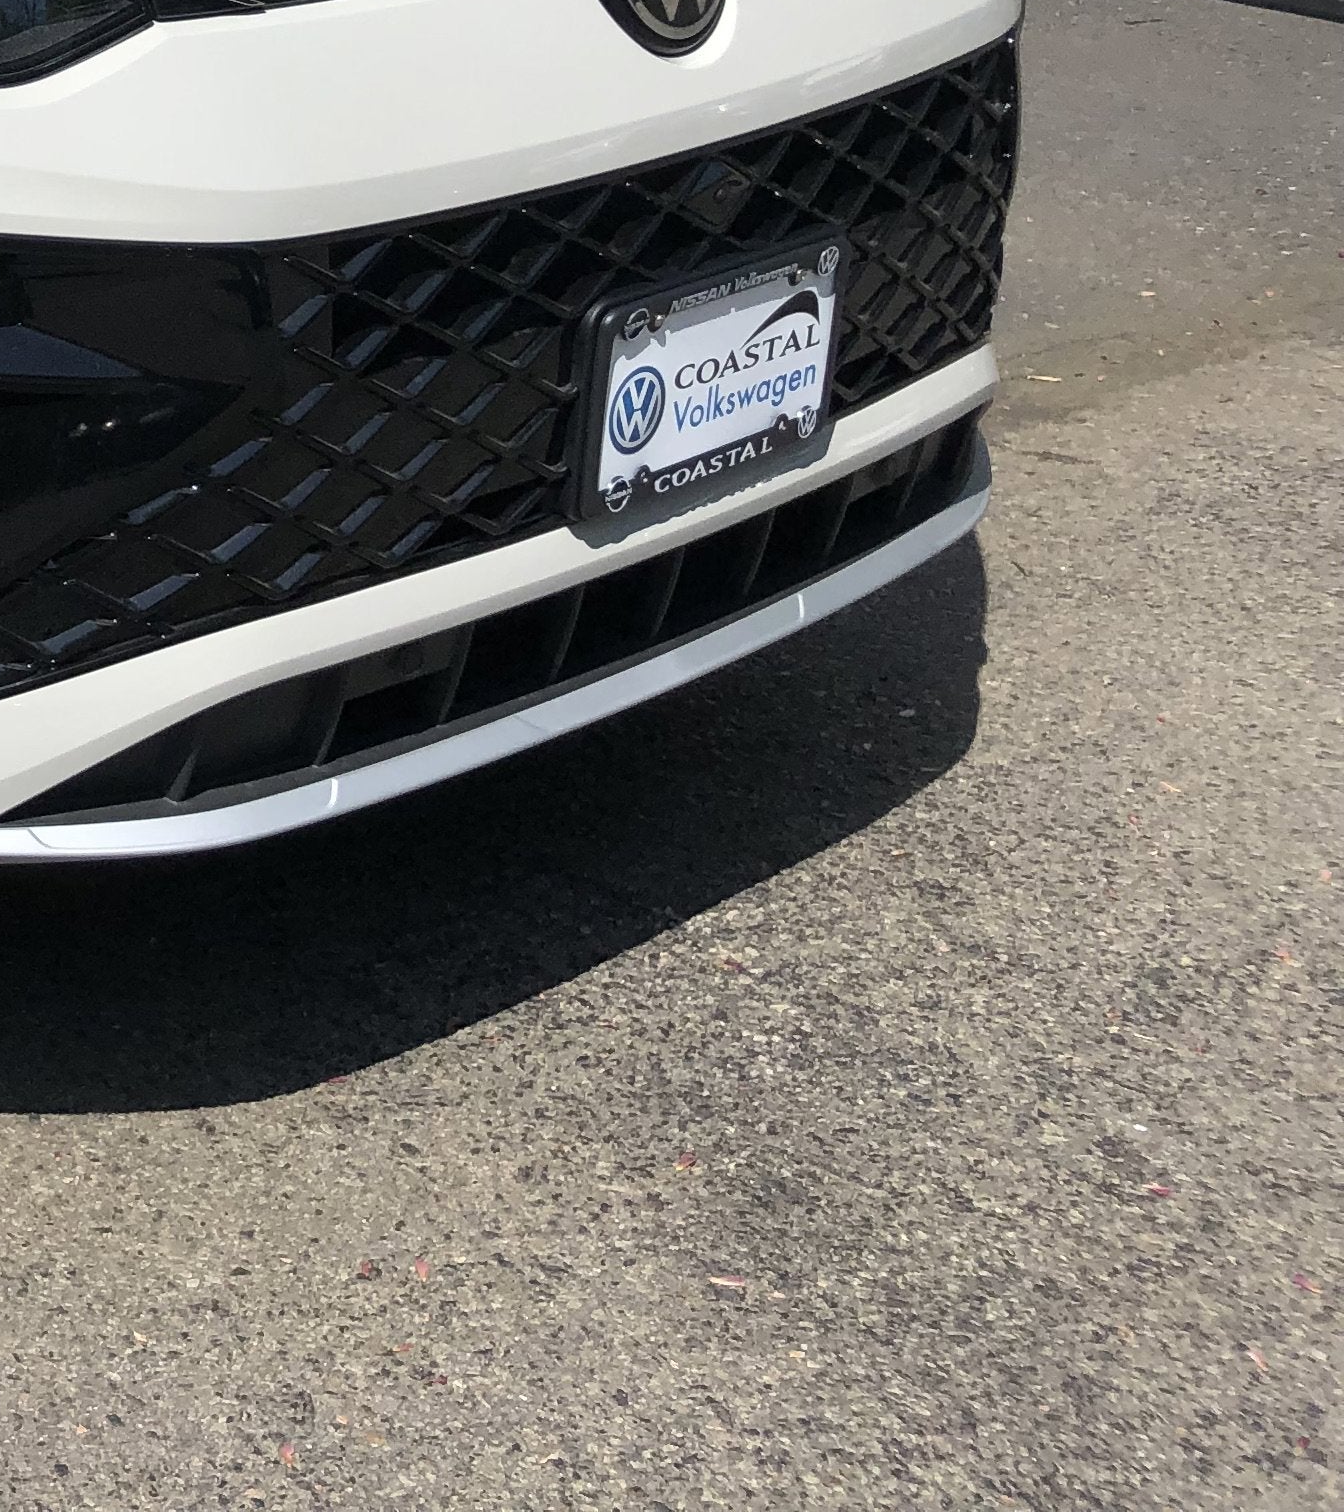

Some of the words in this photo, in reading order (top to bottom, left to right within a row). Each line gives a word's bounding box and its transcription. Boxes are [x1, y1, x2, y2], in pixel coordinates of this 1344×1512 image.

[670, 283, 731, 314] NISSAN
[734, 262, 799, 292] Volkswagen
[674, 323, 821, 389] COASTAL
[673, 364, 817, 434] Volkswagen
[654, 437, 773, 494] COASTAL
